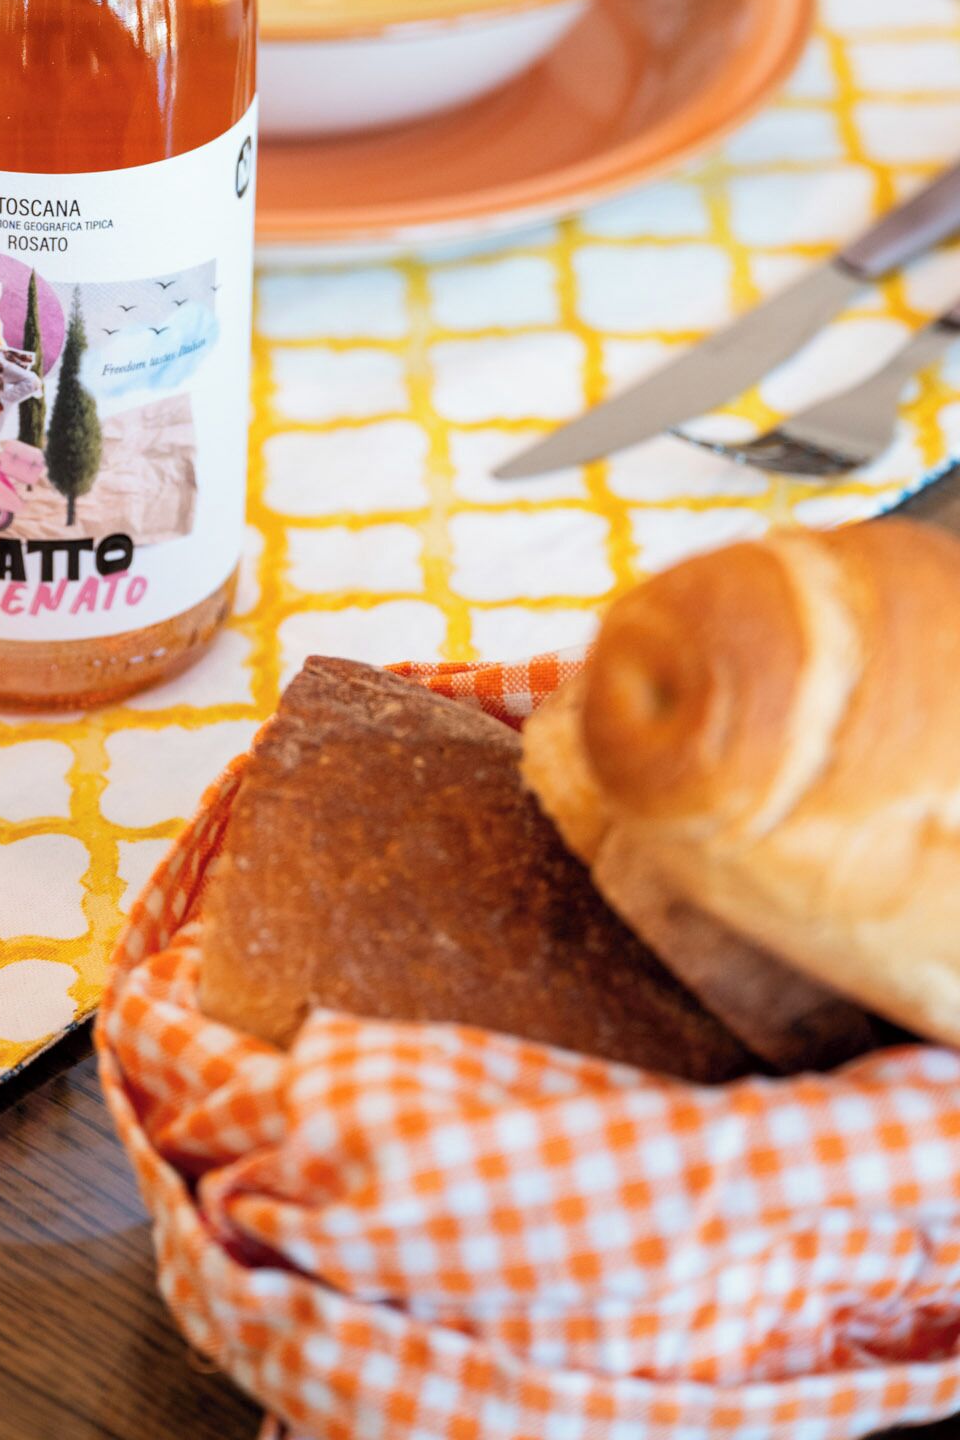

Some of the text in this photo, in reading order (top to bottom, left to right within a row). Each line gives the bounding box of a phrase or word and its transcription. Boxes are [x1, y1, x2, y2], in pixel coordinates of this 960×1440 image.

[24, 221, 82, 232] GEOGRAFICA
[85, 219, 114, 230] TIPICA
[8, 235, 68, 252] ROSATO
[102, 360, 146, 376] Freedom
